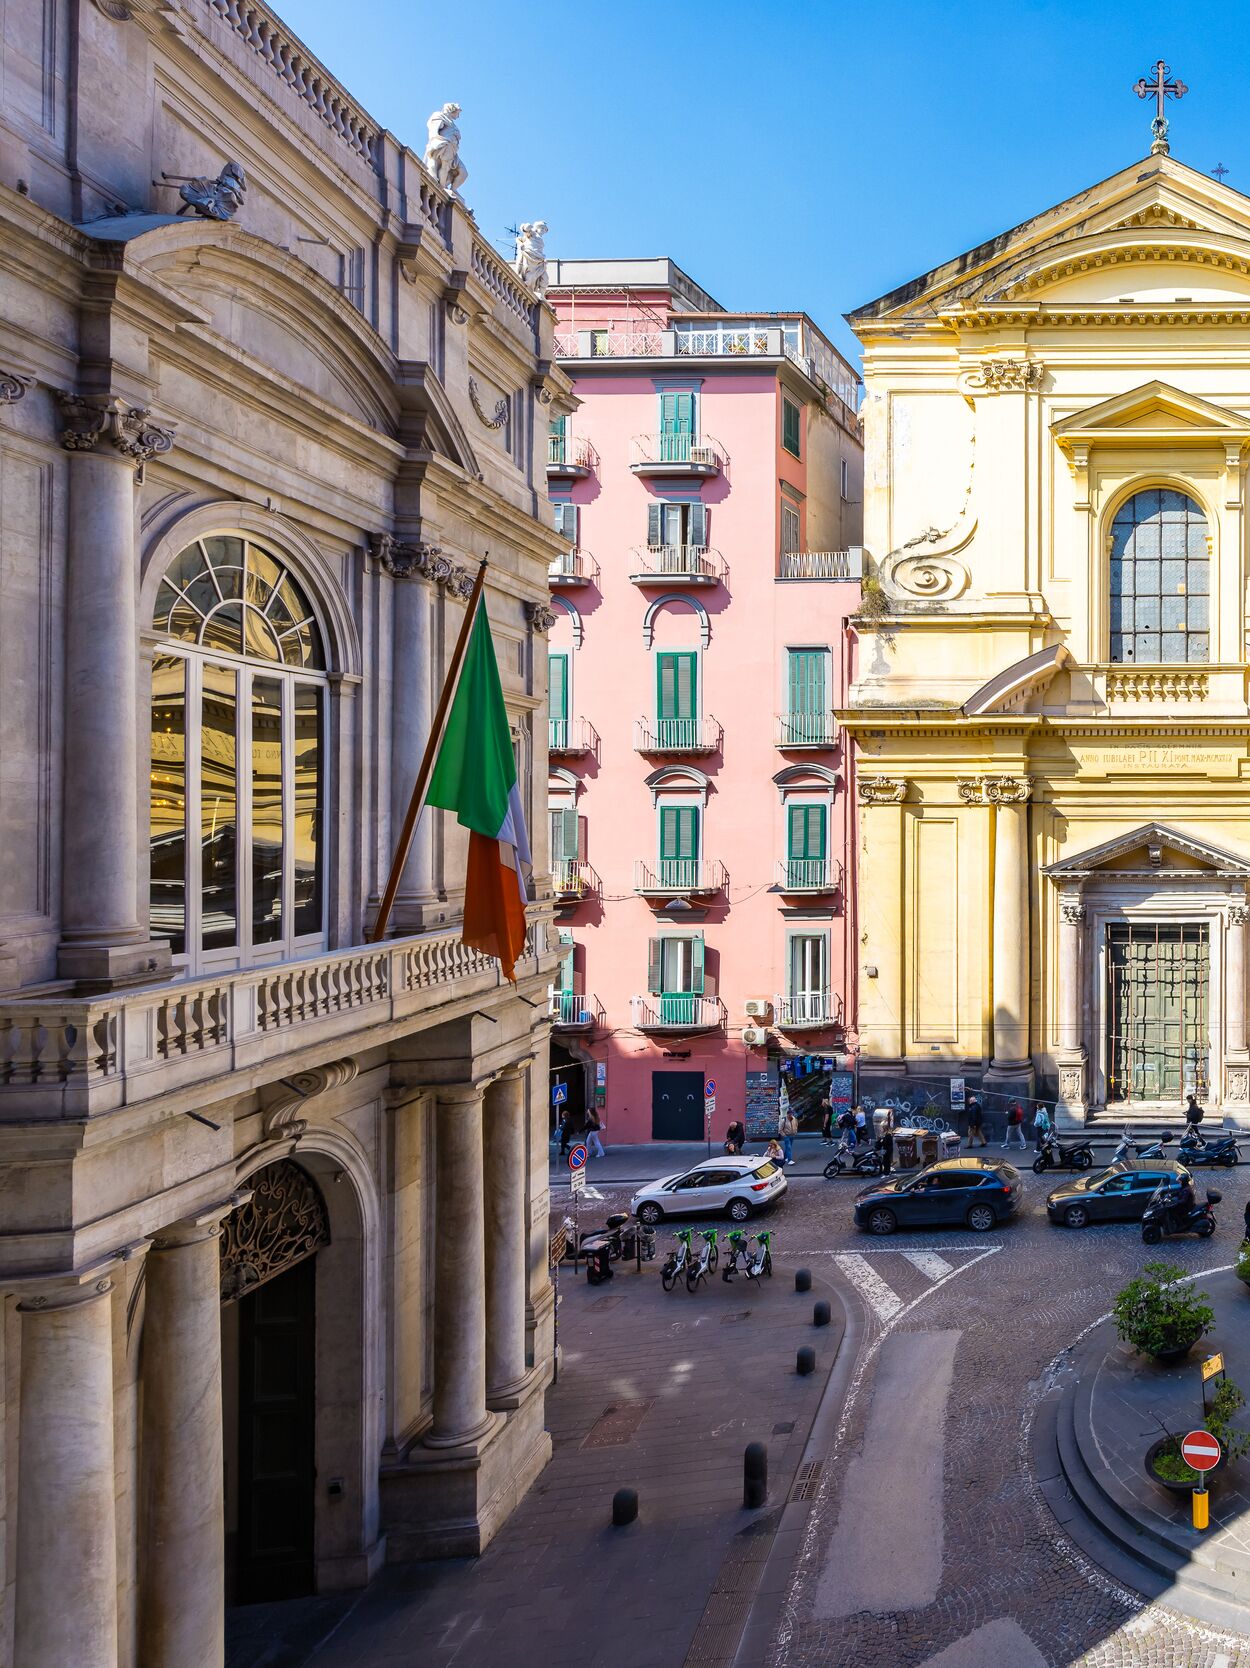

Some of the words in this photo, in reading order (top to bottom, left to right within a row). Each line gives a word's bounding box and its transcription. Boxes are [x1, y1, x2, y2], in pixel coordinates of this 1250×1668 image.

[1080, 754, 1099, 763] ANNO
[1139, 750, 1157, 762] PII
[1162, 750, 1173, 762] XI
